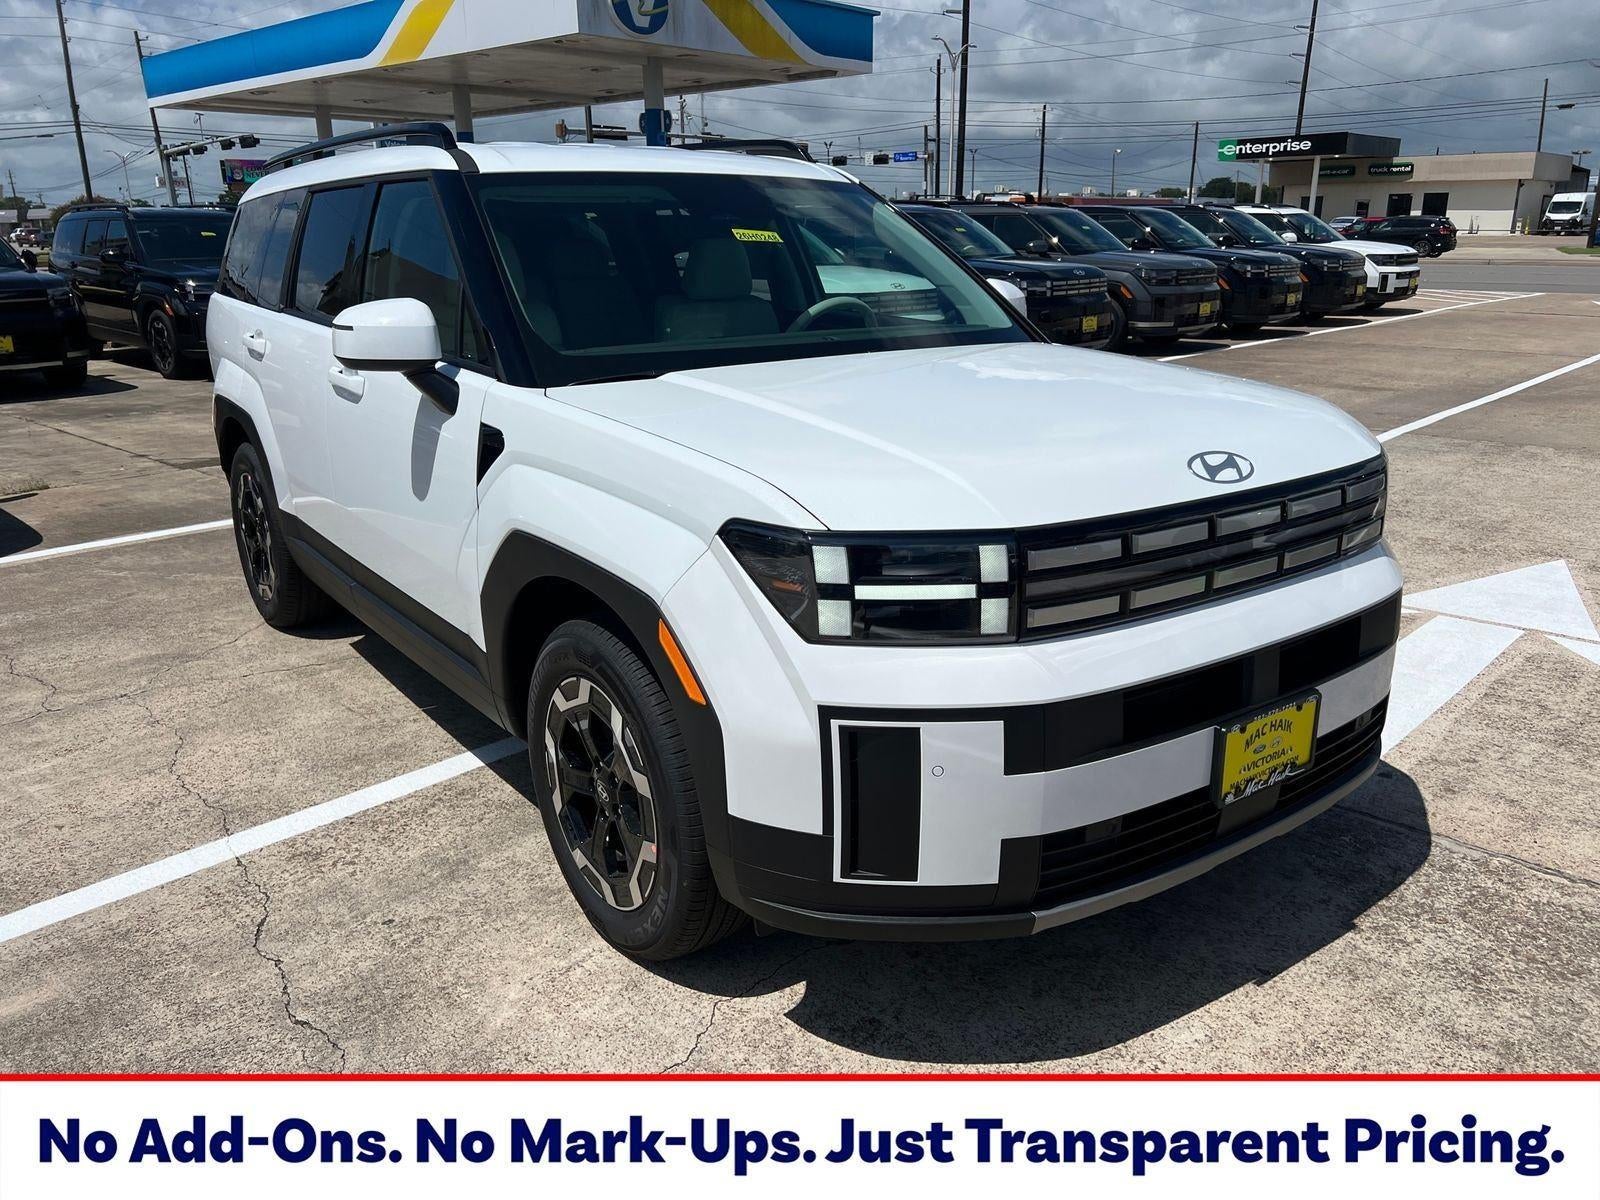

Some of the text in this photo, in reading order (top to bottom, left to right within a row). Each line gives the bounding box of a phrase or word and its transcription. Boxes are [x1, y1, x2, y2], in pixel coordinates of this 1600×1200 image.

[1218, 138, 1312, 156] enterprise
[1244, 718, 1293, 752] MAC HAIK
[1246, 747, 1287, 773] VICTORIA
